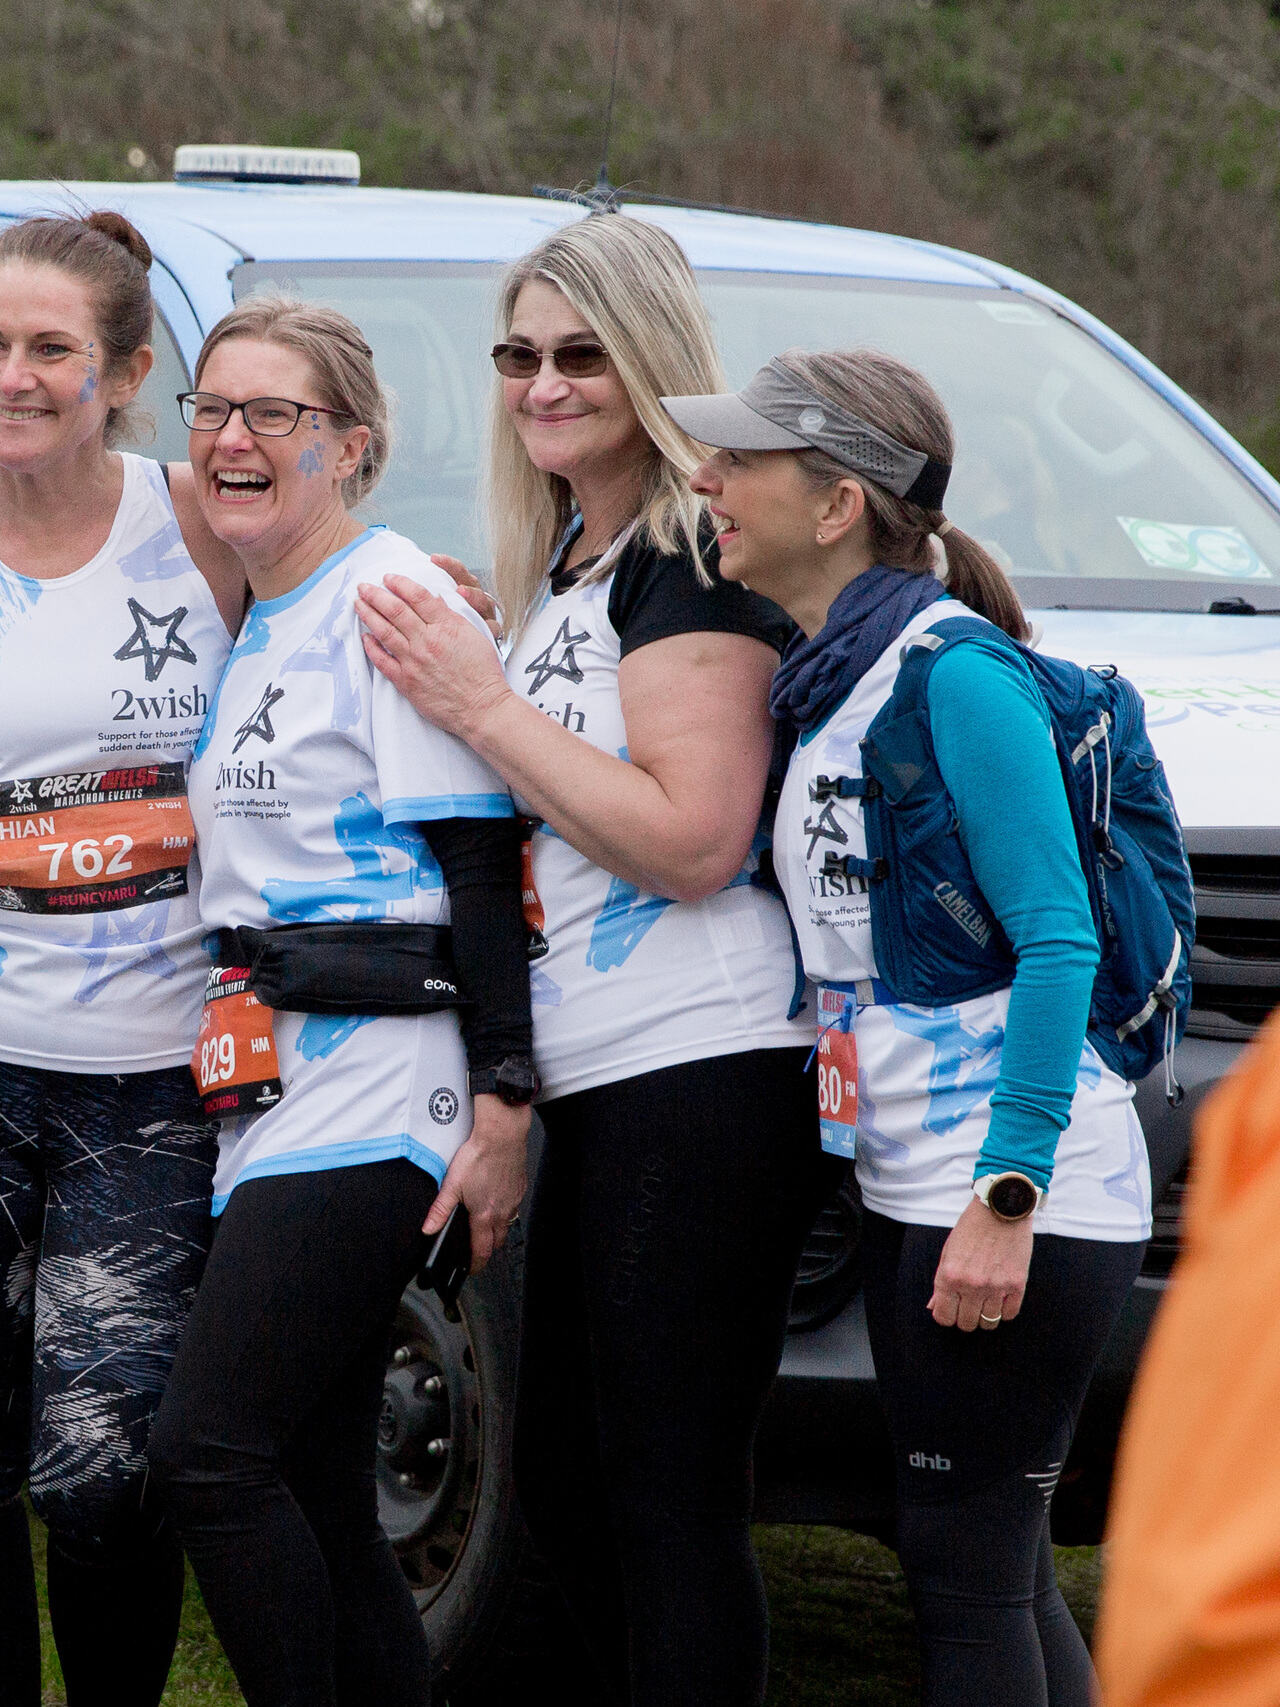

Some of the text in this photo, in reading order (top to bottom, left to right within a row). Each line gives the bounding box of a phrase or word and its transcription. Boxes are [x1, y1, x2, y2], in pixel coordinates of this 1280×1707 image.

[111, 684, 208, 721] 2wish
[98, 731, 136, 742] Support
[140, 730, 152, 739] for
[156, 730, 178, 738] those
[99, 743, 132, 752] sudden
[136, 741, 160, 750] death
[172, 740, 192, 750] young
[54, 788, 143, 808] MARATHON EVENTS
[246, 799, 275, 808] affected
[278, 800, 288, 808] by
[9, 803, 38, 814] 2wish
[156, 801, 182, 810] WISH
[244, 811, 264, 820] young
[266, 810, 291, 820] people
[162, 836, 188, 850] HM
[38, 834, 134, 882] 762
[48, 885, 137, 906] #RUNCYMRU
[835, 904, 870, 915] affected
[830, 919, 856, 928] young
[225, 980, 246, 995] EVENTS
[251, 1036, 270, 1054] HM
[200, 1033, 236, 1088] 829
[846, 1080, 856, 1097] FM
[909, 1452, 952, 1471] dhb
